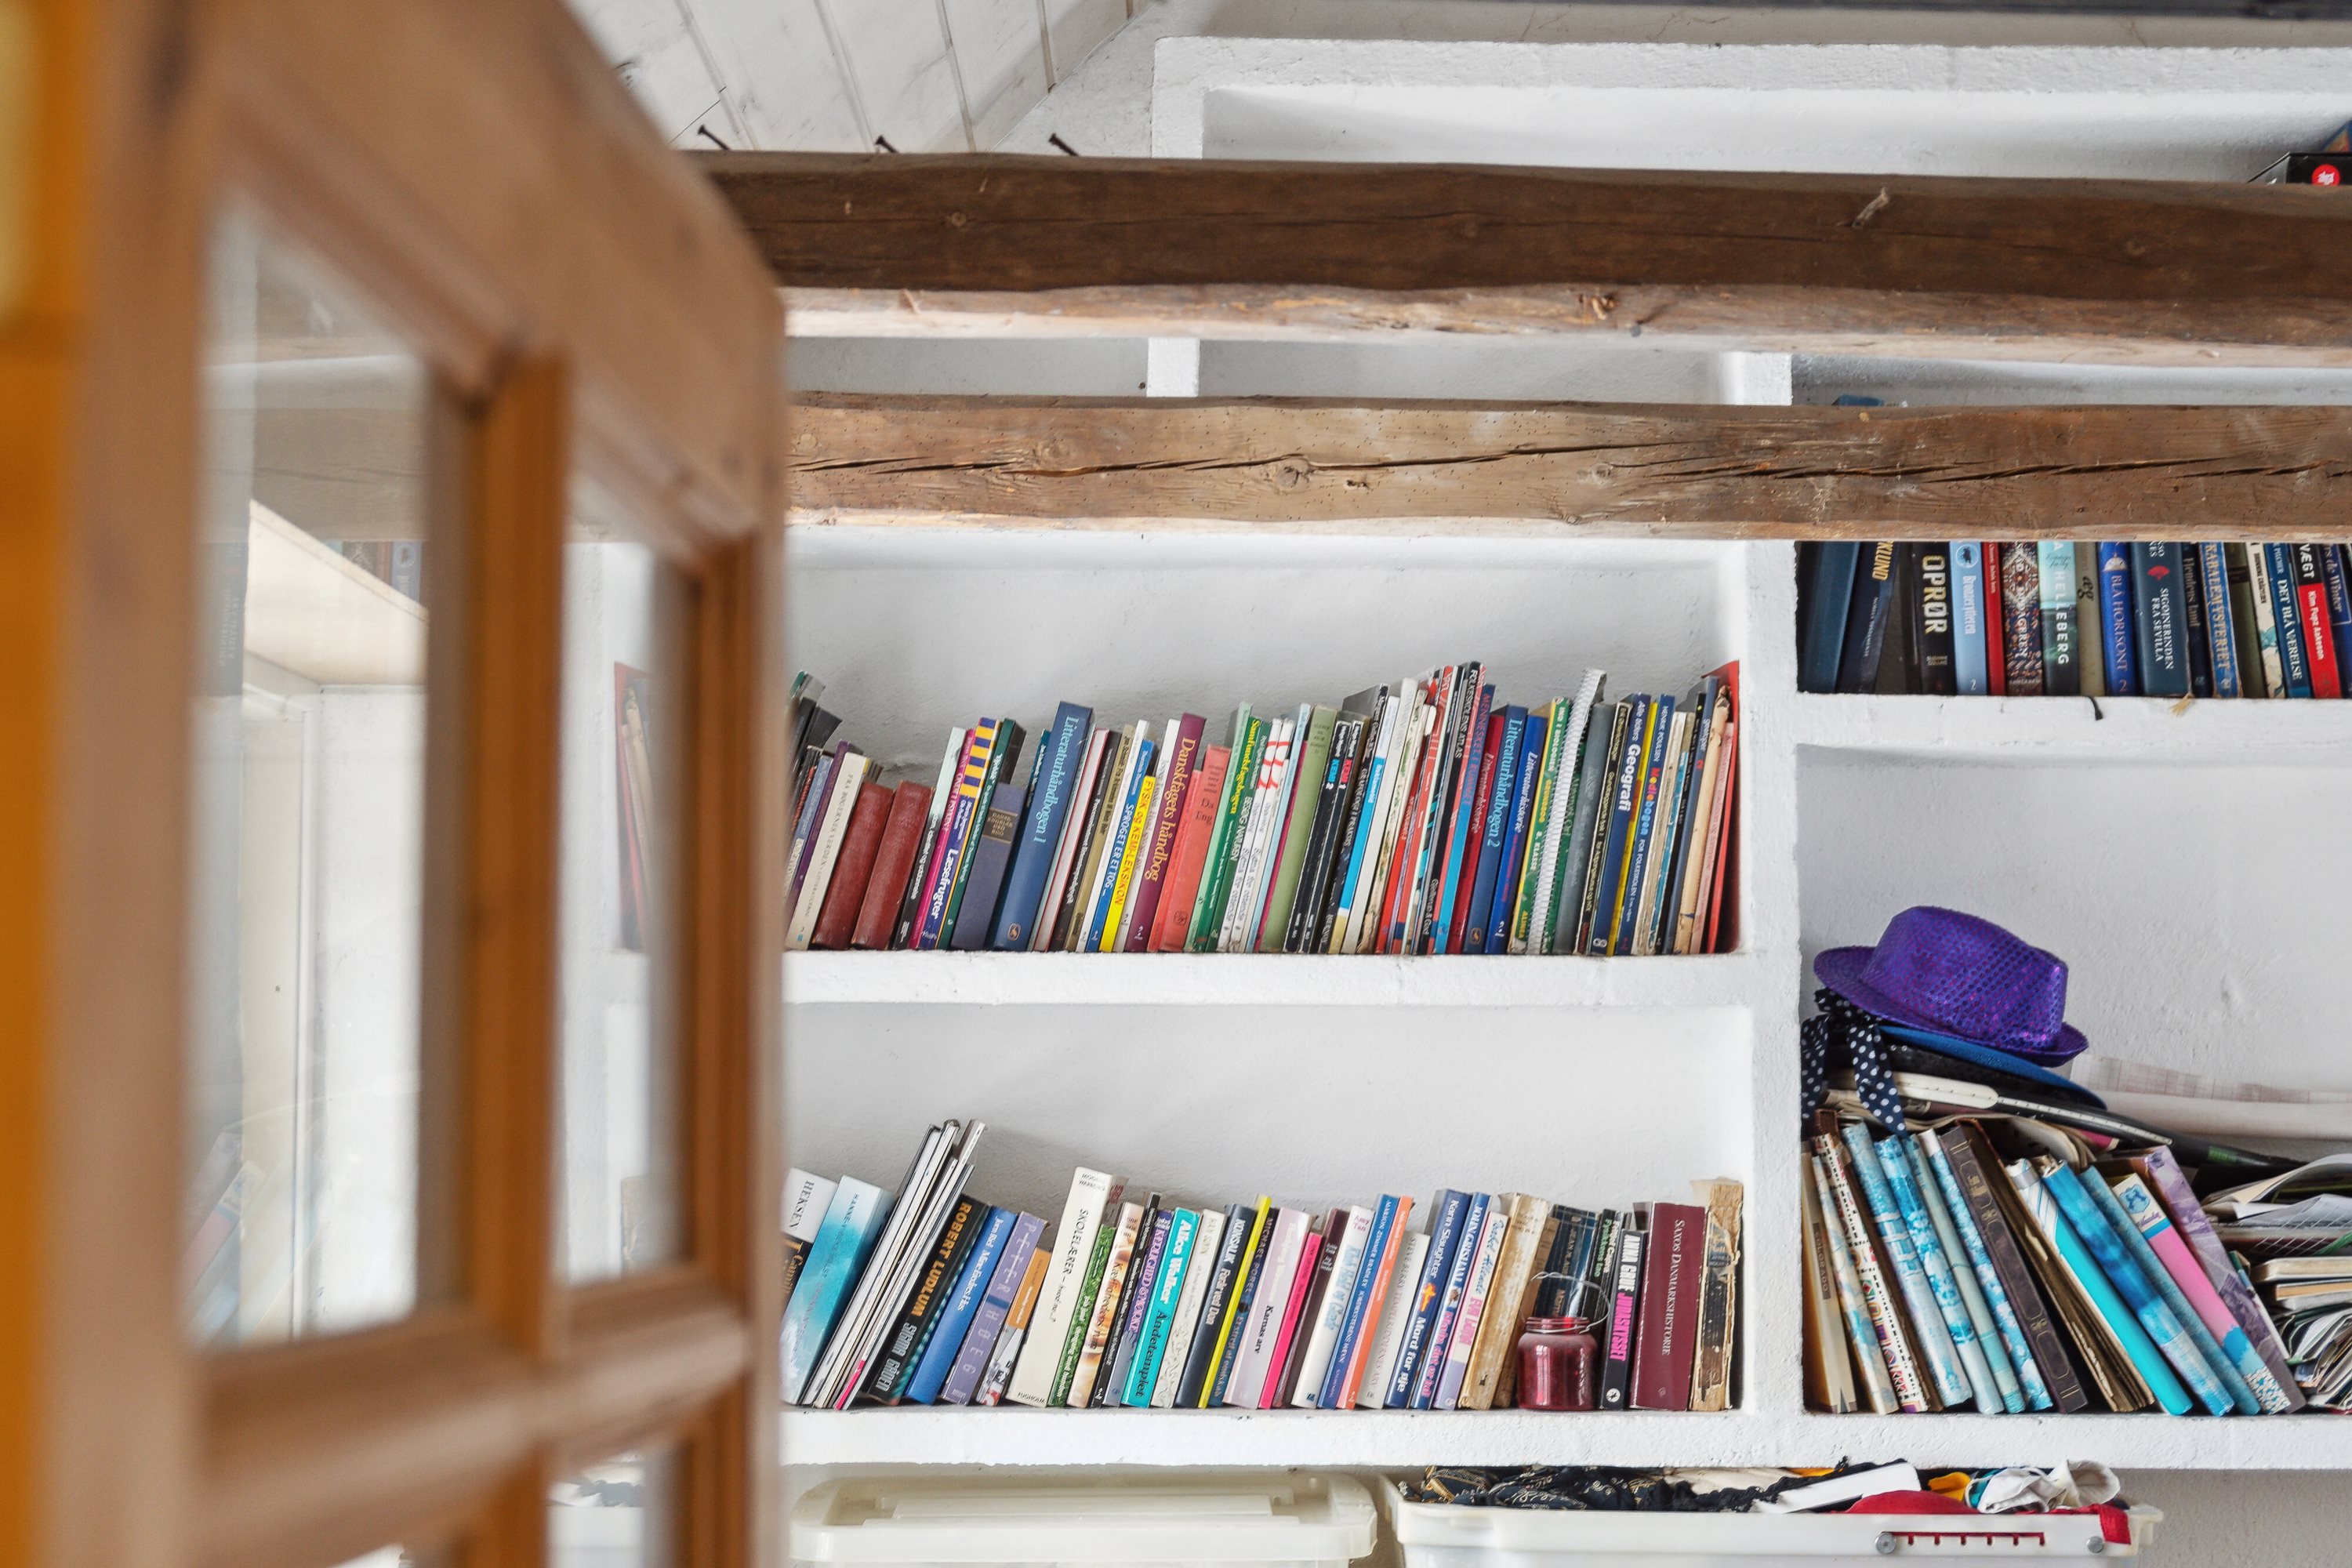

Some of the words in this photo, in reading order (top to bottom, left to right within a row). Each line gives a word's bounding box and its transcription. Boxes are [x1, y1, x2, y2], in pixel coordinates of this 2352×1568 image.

[2272, 546, 2285, 574] PILCHER
[1921, 554, 1947, 633] OPRØR
[2075, 575, 2095, 602] æg
[2110, 574, 2125, 597] BLÅ
[2276, 579, 2291, 604] DET
[2307, 590, 2318, 606] Kim
[2053, 570, 2069, 664] HELLEBERG
[2150, 597, 2161, 617] FRA
[2203, 543, 2230, 670] KABALEMYSTERIET
[2280, 604, 2296, 629] BLÅ
[2111, 601, 2128, 672] HORISONT
[2151, 618, 2164, 662] SEVILLA
[2158, 586, 2174, 670] SIGØJNERINDEN
[2312, 626, 2325, 660] Aakeson
[2284, 627, 2303, 681] VÆRELSE
[1457, 668, 1479, 733] FOLKESKOLENS
[1634, 700, 1646, 717] Alle
[1657, 704, 1668, 731] HENRIK
[1470, 692, 1491, 755] MENNESKET
[1453, 731, 1466, 759] ATLAS
[1546, 728, 1562, 773] BIOLOGIEN
[1651, 730, 1664, 762] POULSEN
[840, 772, 854, 789] FRA
[1031, 714, 1080, 834] Litteraturhåndbogen
[1158, 735, 1197, 820] Danskfagets
[1227, 717, 1261, 815] Samfundsfagsbogen
[1327, 757, 1340, 784] KEMI
[1339, 757, 1352, 784] KEMI
[1460, 762, 1478, 806] RUMMET
[1483, 717, 1523, 839] Litteraturhåndbogen
[1613, 742, 1642, 813] Geografi
[1138, 779, 1155, 810] FYSIK
[1324, 781, 1334, 791] 2
[1512, 750, 1538, 834] Litteraturhistorie
[1638, 766, 1660, 837] Mediebogen
[1115, 802, 1134, 846] SPROGET
[1131, 810, 1145, 825] og
[1032, 835, 1047, 845] 1
[1111, 844, 1123, 859] ER
[1142, 818, 1176, 884] håndbog
[1485, 837, 1501, 849] 2
[1635, 838, 1645, 853] FOR
[1108, 858, 1120, 871] ET
[1112, 825, 1142, 906] KEMI-LEKSIKON
[1628, 852, 1642, 898] FOLKESKOLEN
[927, 847, 959, 920] Læsefrugter
[1591, 938, 1608, 949] 8
[785, 1178, 815, 1232] HEKSEN
[1377, 1198, 1392, 1231] MARION
[1443, 1198, 1459, 1228] Karin
[1467, 1203, 1484, 1233] JOHN
[936, 1200, 973, 1260] ROBERT
[1061, 1207, 1089, 1276] SKOLELÆRER
[1171, 1218, 1193, 1257] Alice
[1222, 1217, 1246, 1265] KONSALIK
[1254, 1215, 1274, 1259] MICHAEL
[1369, 1228, 1385, 1259] ZIMMER
[1485, 1217, 1505, 1253] Isabel
[1595, 1217, 1611, 1262] Fysikkens
[1671, 1218, 1685, 1252] SAXOS
[995, 1221, 1038, 1294] PETER
[1139, 1227, 1165, 1287] KÆRLIGHED
[1403, 1236, 1416, 1262] STEVE
[1428, 1225, 1451, 1279] Slaughter
[1453, 1230, 1476, 1284] GRISHAM
[1621, 1233, 1641, 1264] ANNA
[1813, 1231, 1829, 1291] COLORADO
[1158, 1254, 1183, 1305] Walker
[1359, 1257, 1376, 1289] BRADLEY
[1396, 1262, 1410, 1289] BERRY
[1473, 1253, 1496, 1298] Allende
[1593, 1262, 1603, 1278] tao
[1617, 1263, 1637, 1292] GRUE
[909, 1258, 946, 1319] LUDLUM
[1093, 1261, 1123, 1329] Kærlighedens
[1660, 1253, 1681, 1356] DANMARKSHISTORIE
[1127, 1294, 1147, 1333] MØRKE
[1203, 1305, 1219, 1327] Don
[1257, 1303, 1274, 1338] Karnas
[1465, 1296, 1483, 1319] EVA
[890, 1321, 917, 1358] SIGMA
[1407, 1315, 1426, 1351] Mord
[1457, 1317, 1479, 1348] LUNA
[1608, 1291, 1633, 1362] JUDASKYSSET
[1253, 1338, 1264, 1355] arv
[1402, 1349, 1417, 1370] for
[873, 1356, 903, 1394] GÅDEN
[1395, 1370, 1410, 1393] øje
